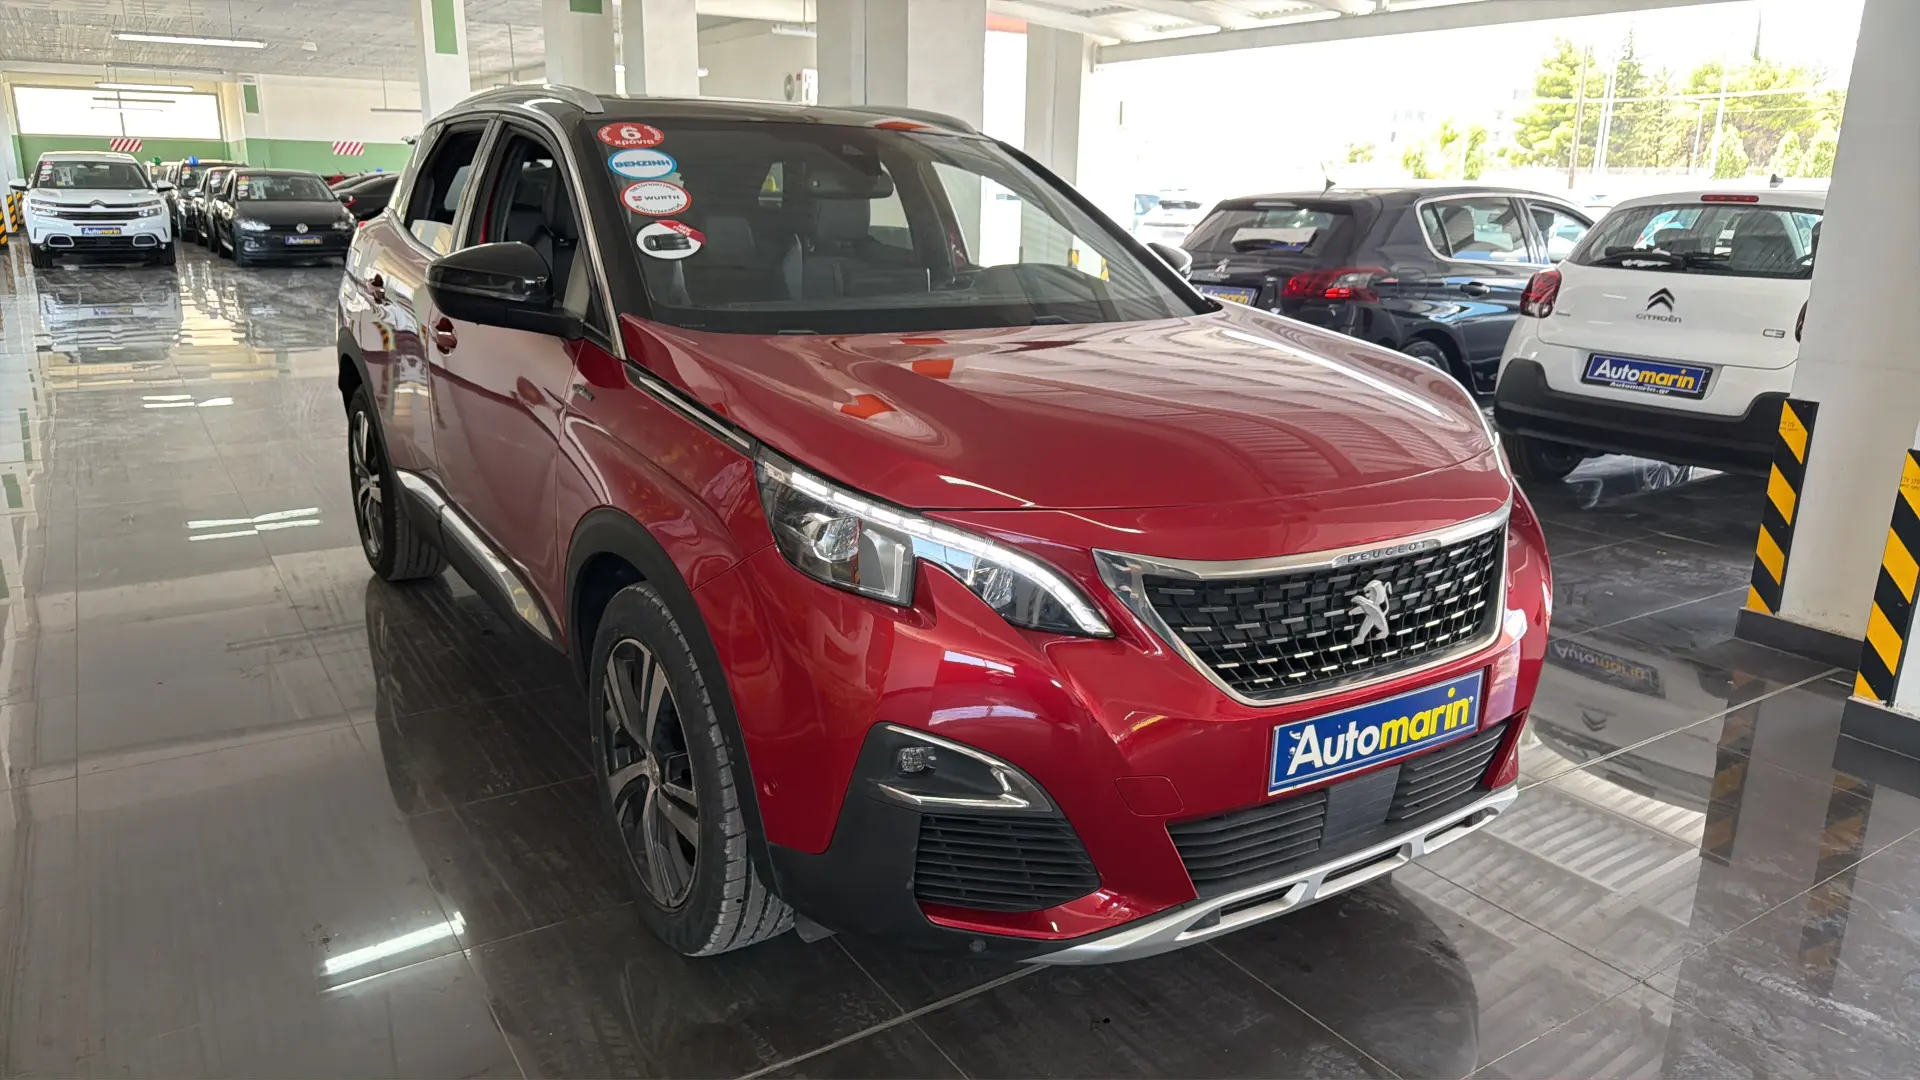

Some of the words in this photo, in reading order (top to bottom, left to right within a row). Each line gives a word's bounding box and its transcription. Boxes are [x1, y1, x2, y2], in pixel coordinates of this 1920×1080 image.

[620, 126, 642, 140] 6
[84, 227, 121, 236] Automarin
[1762, 328, 1786, 339] C3
[1594, 359, 1695, 390] Automarin
[1609, 381, 1670, 395] Automarin.gr
[1347, 540, 1428, 563] PEUGEOT
[1286, 687, 1470, 776] Automarin
